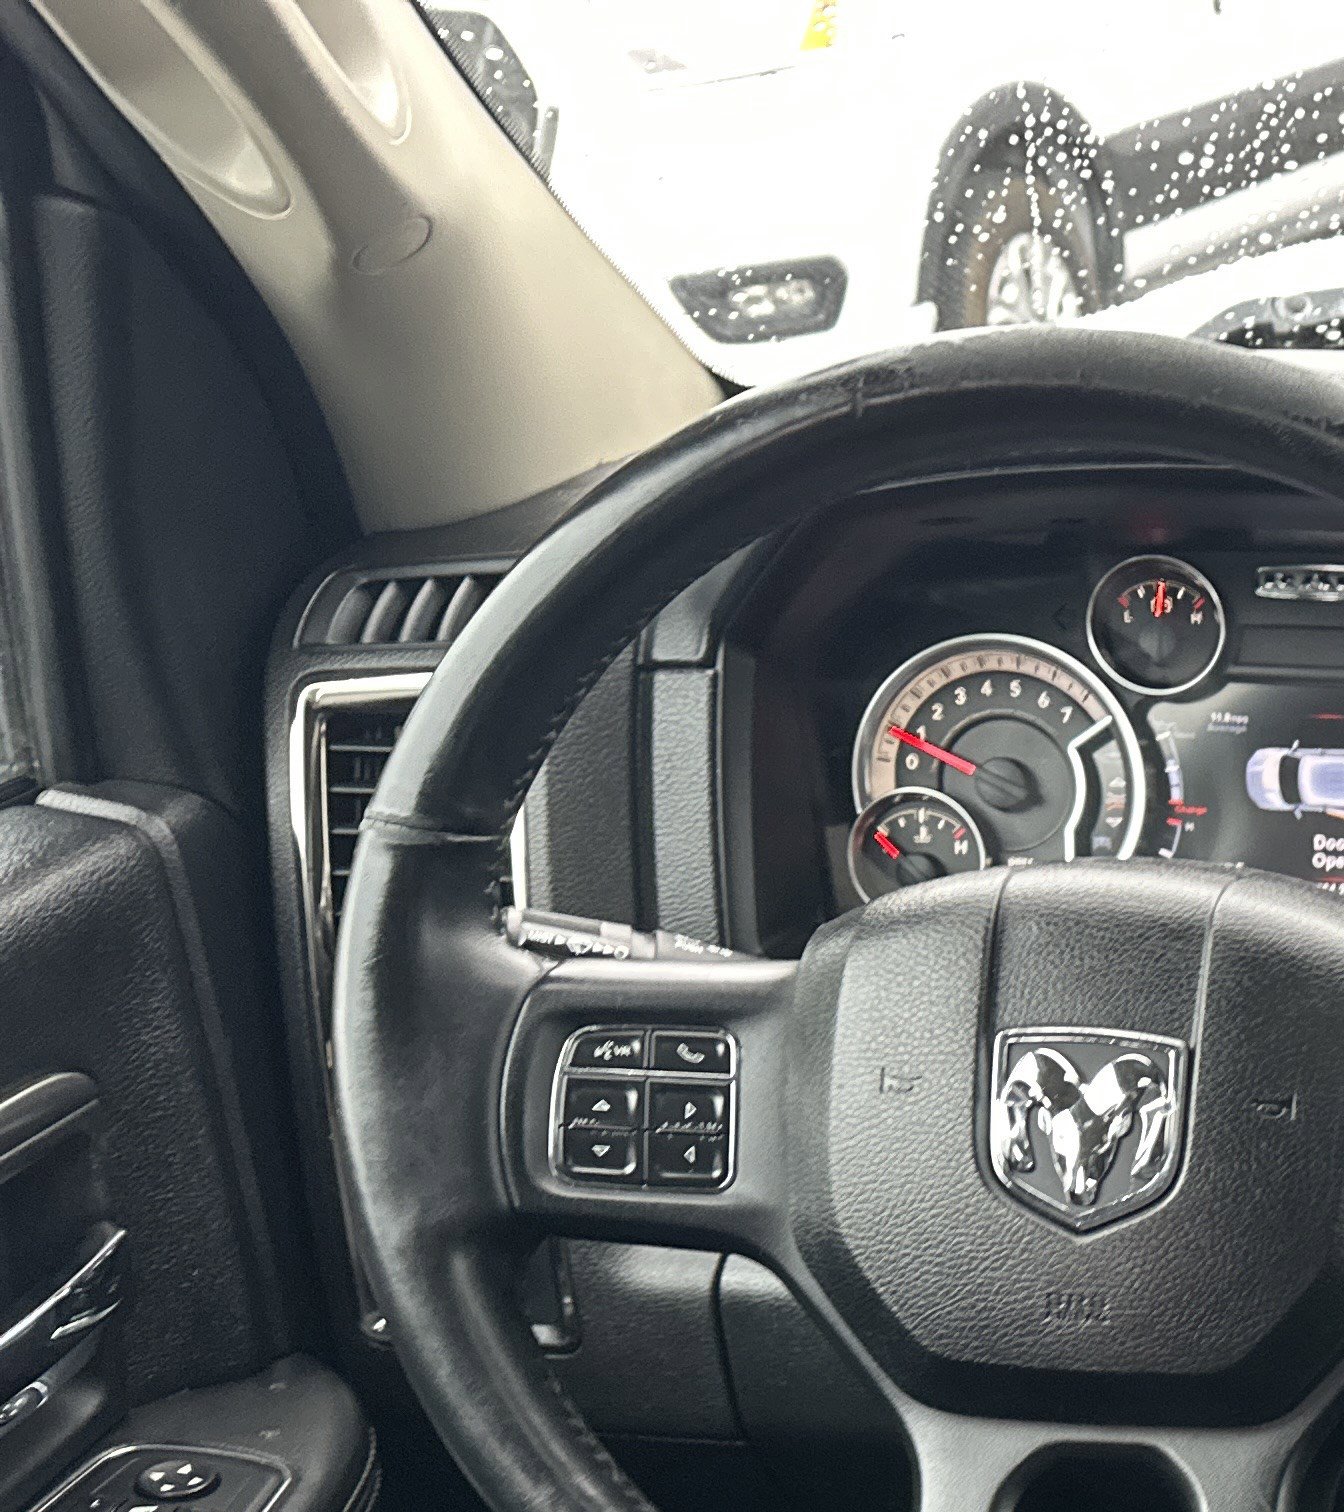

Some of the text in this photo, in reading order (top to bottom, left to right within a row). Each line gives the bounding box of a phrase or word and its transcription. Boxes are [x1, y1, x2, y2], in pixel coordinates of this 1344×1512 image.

[953, 685, 968, 706] 3
[980, 679, 994, 698] 4
[1008, 679, 1022, 698] 5
[1036, 690, 1051, 709] 6
[930, 702, 945, 721] 2
[1059, 705, 1074, 724] 7
[905, 752, 920, 771] 0
[953, 840, 969, 856] H
